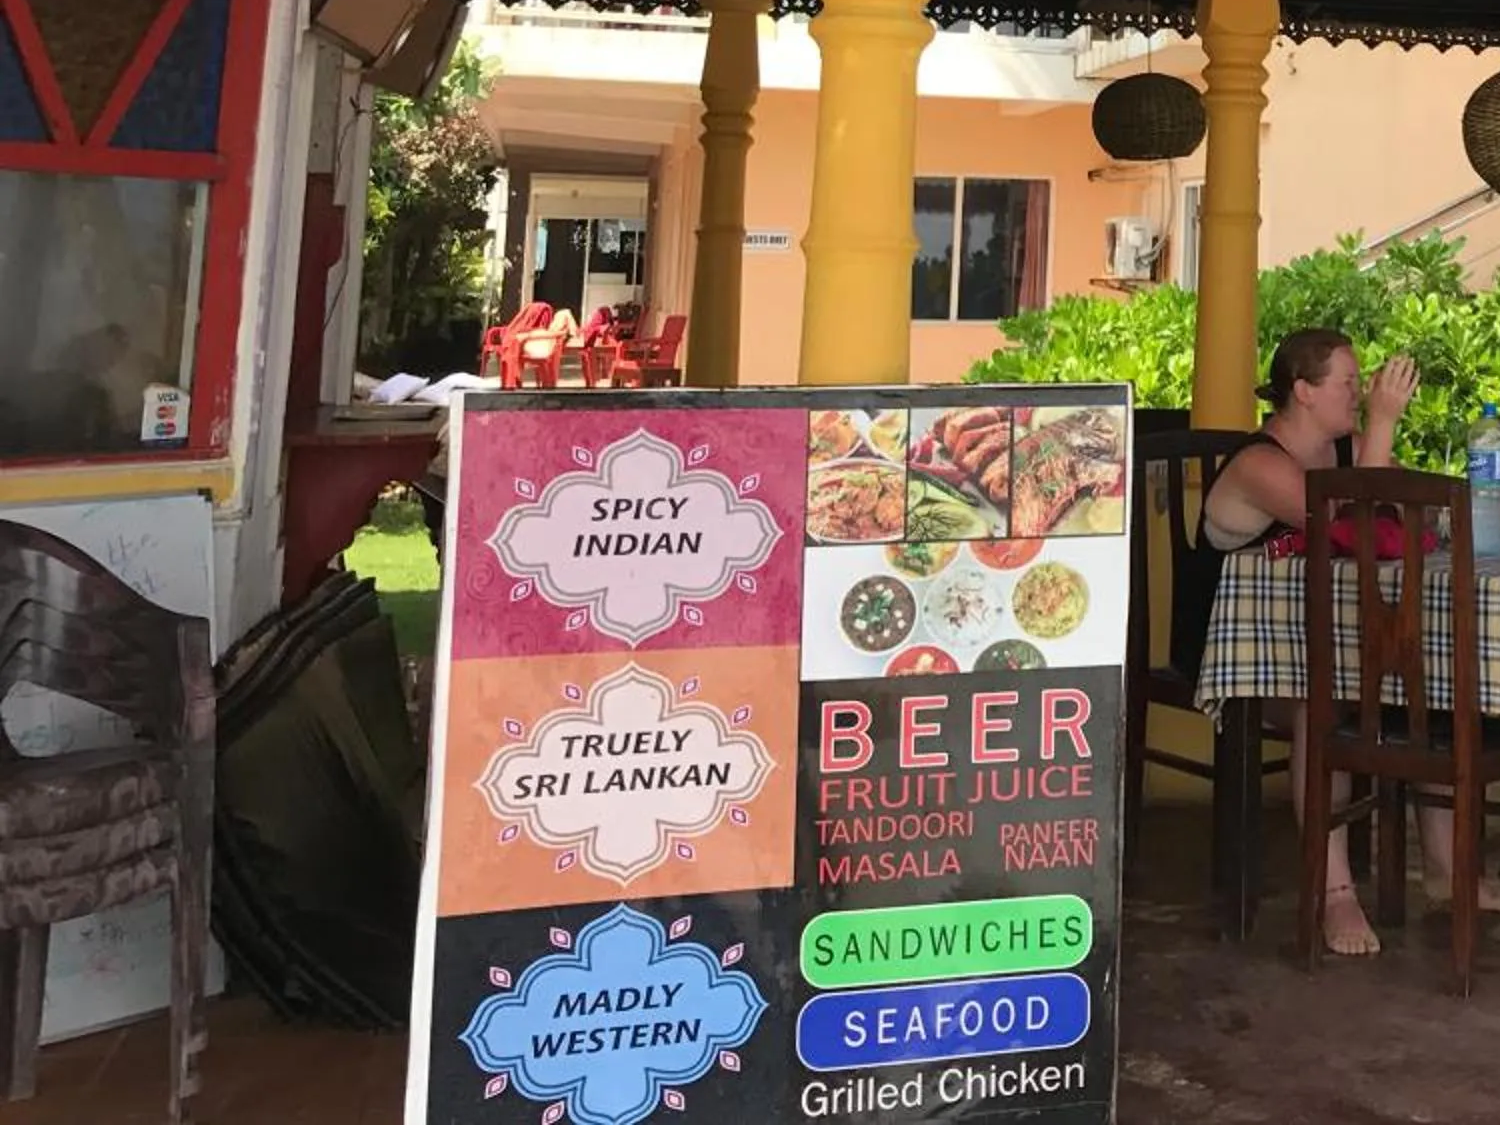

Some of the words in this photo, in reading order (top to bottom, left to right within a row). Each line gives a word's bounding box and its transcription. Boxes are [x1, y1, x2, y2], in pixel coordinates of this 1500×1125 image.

[592, 497, 689, 521] SPICY
[573, 532, 702, 557] INDIAN
[561, 729, 691, 759] TRUELY
[820, 688, 1092, 773] BEER
[514, 773, 570, 800] SRI
[583, 763, 731, 794] LANKAN
[820, 772, 956, 813] FRUIT
[968, 764, 1093, 803] JUICE
[815, 810, 974, 846] TANDOORI
[1000, 818, 1098, 846] PANEER
[819, 848, 961, 885] MASALA
[1004, 839, 1094, 871] NAAN
[813, 916, 1083, 966] SANDWICHES
[553, 982, 683, 1019] MADLY
[531, 1018, 701, 1059] WESTERN
[843, 996, 1050, 1047] SEAFOOD
[801, 1072, 923, 1117] Grilled
[938, 1061, 1086, 1103] Chicken
